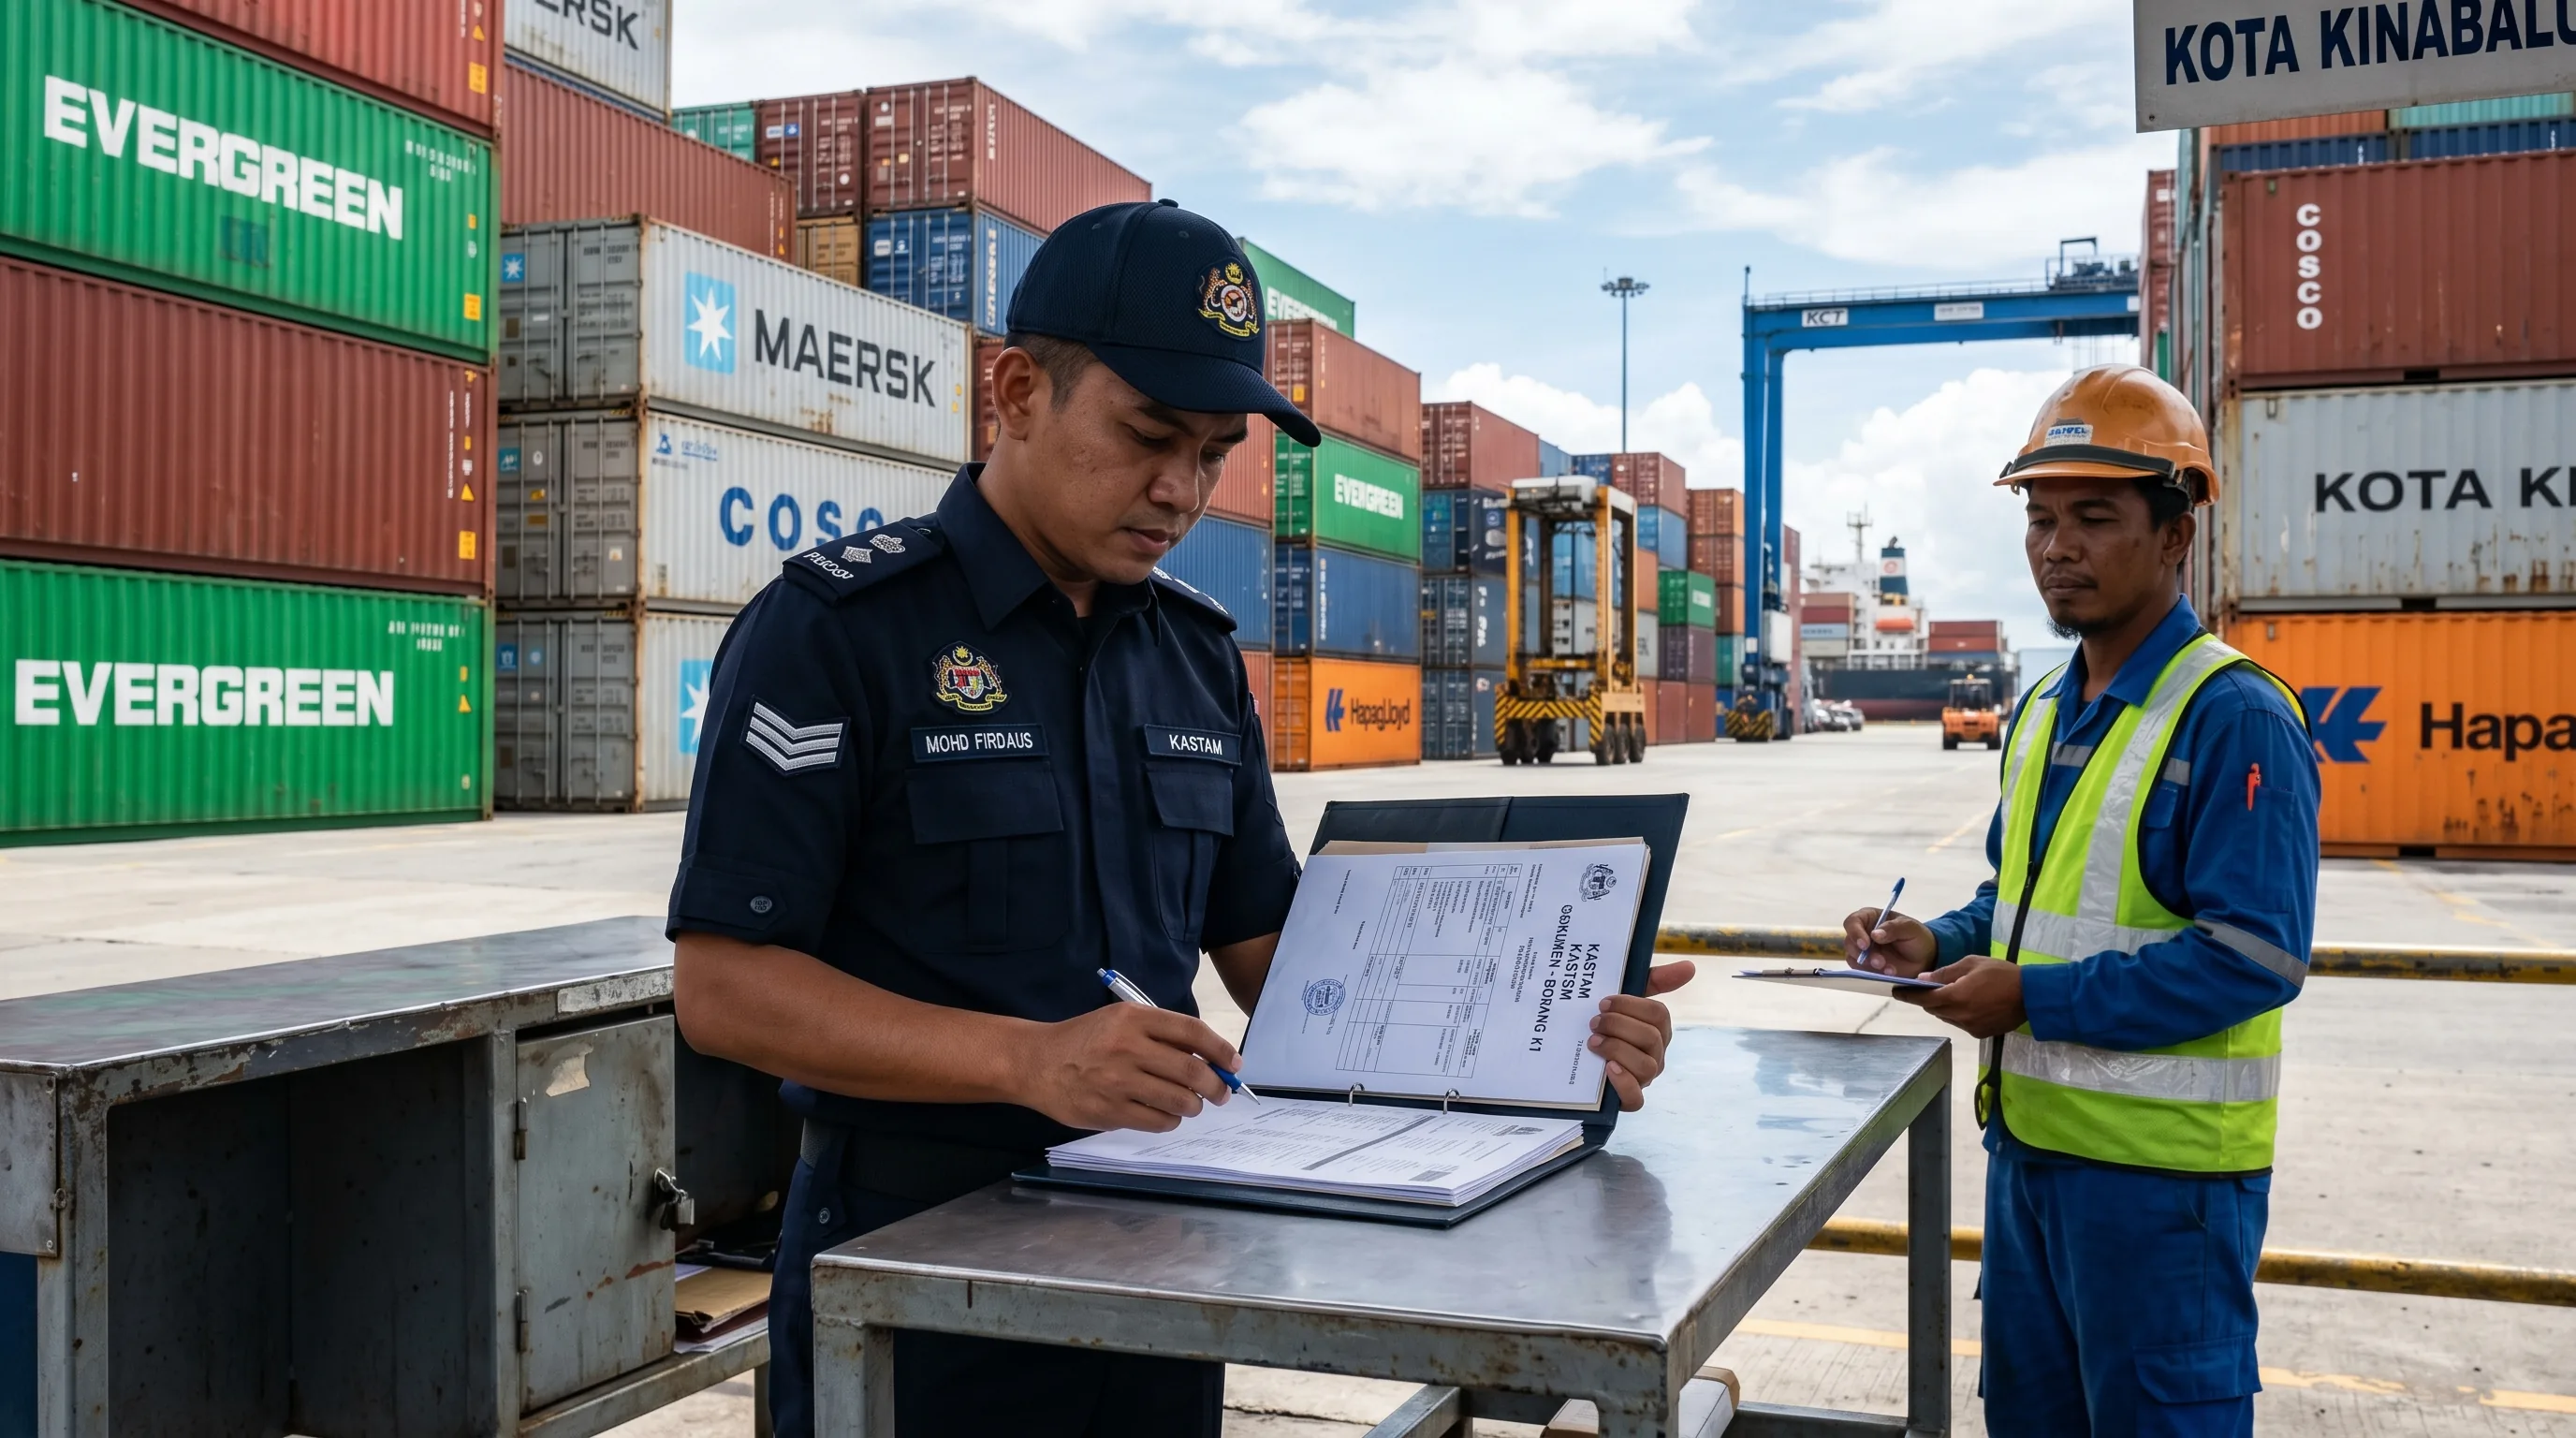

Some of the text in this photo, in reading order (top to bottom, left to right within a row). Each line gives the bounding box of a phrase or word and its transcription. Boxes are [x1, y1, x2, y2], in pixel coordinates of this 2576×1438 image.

[2165, 15, 2300, 85] KOTA
[43, 75, 402, 241] EVERGREEN
[2296, 203, 2322, 330] COSCO
[1807, 310, 1845, 324] KCT
[754, 309, 936, 408] MAERSK
[2315, 468, 2493, 512] KOTA
[15, 659, 394, 726] EVERGREEN
[926, 732, 1033, 754] MOHD FIRDAUS
[1169, 734, 1223, 756] KASTAM
[1578, 944, 1600, 999] KASTAM
[1530, 1037, 1544, 1052] K1
